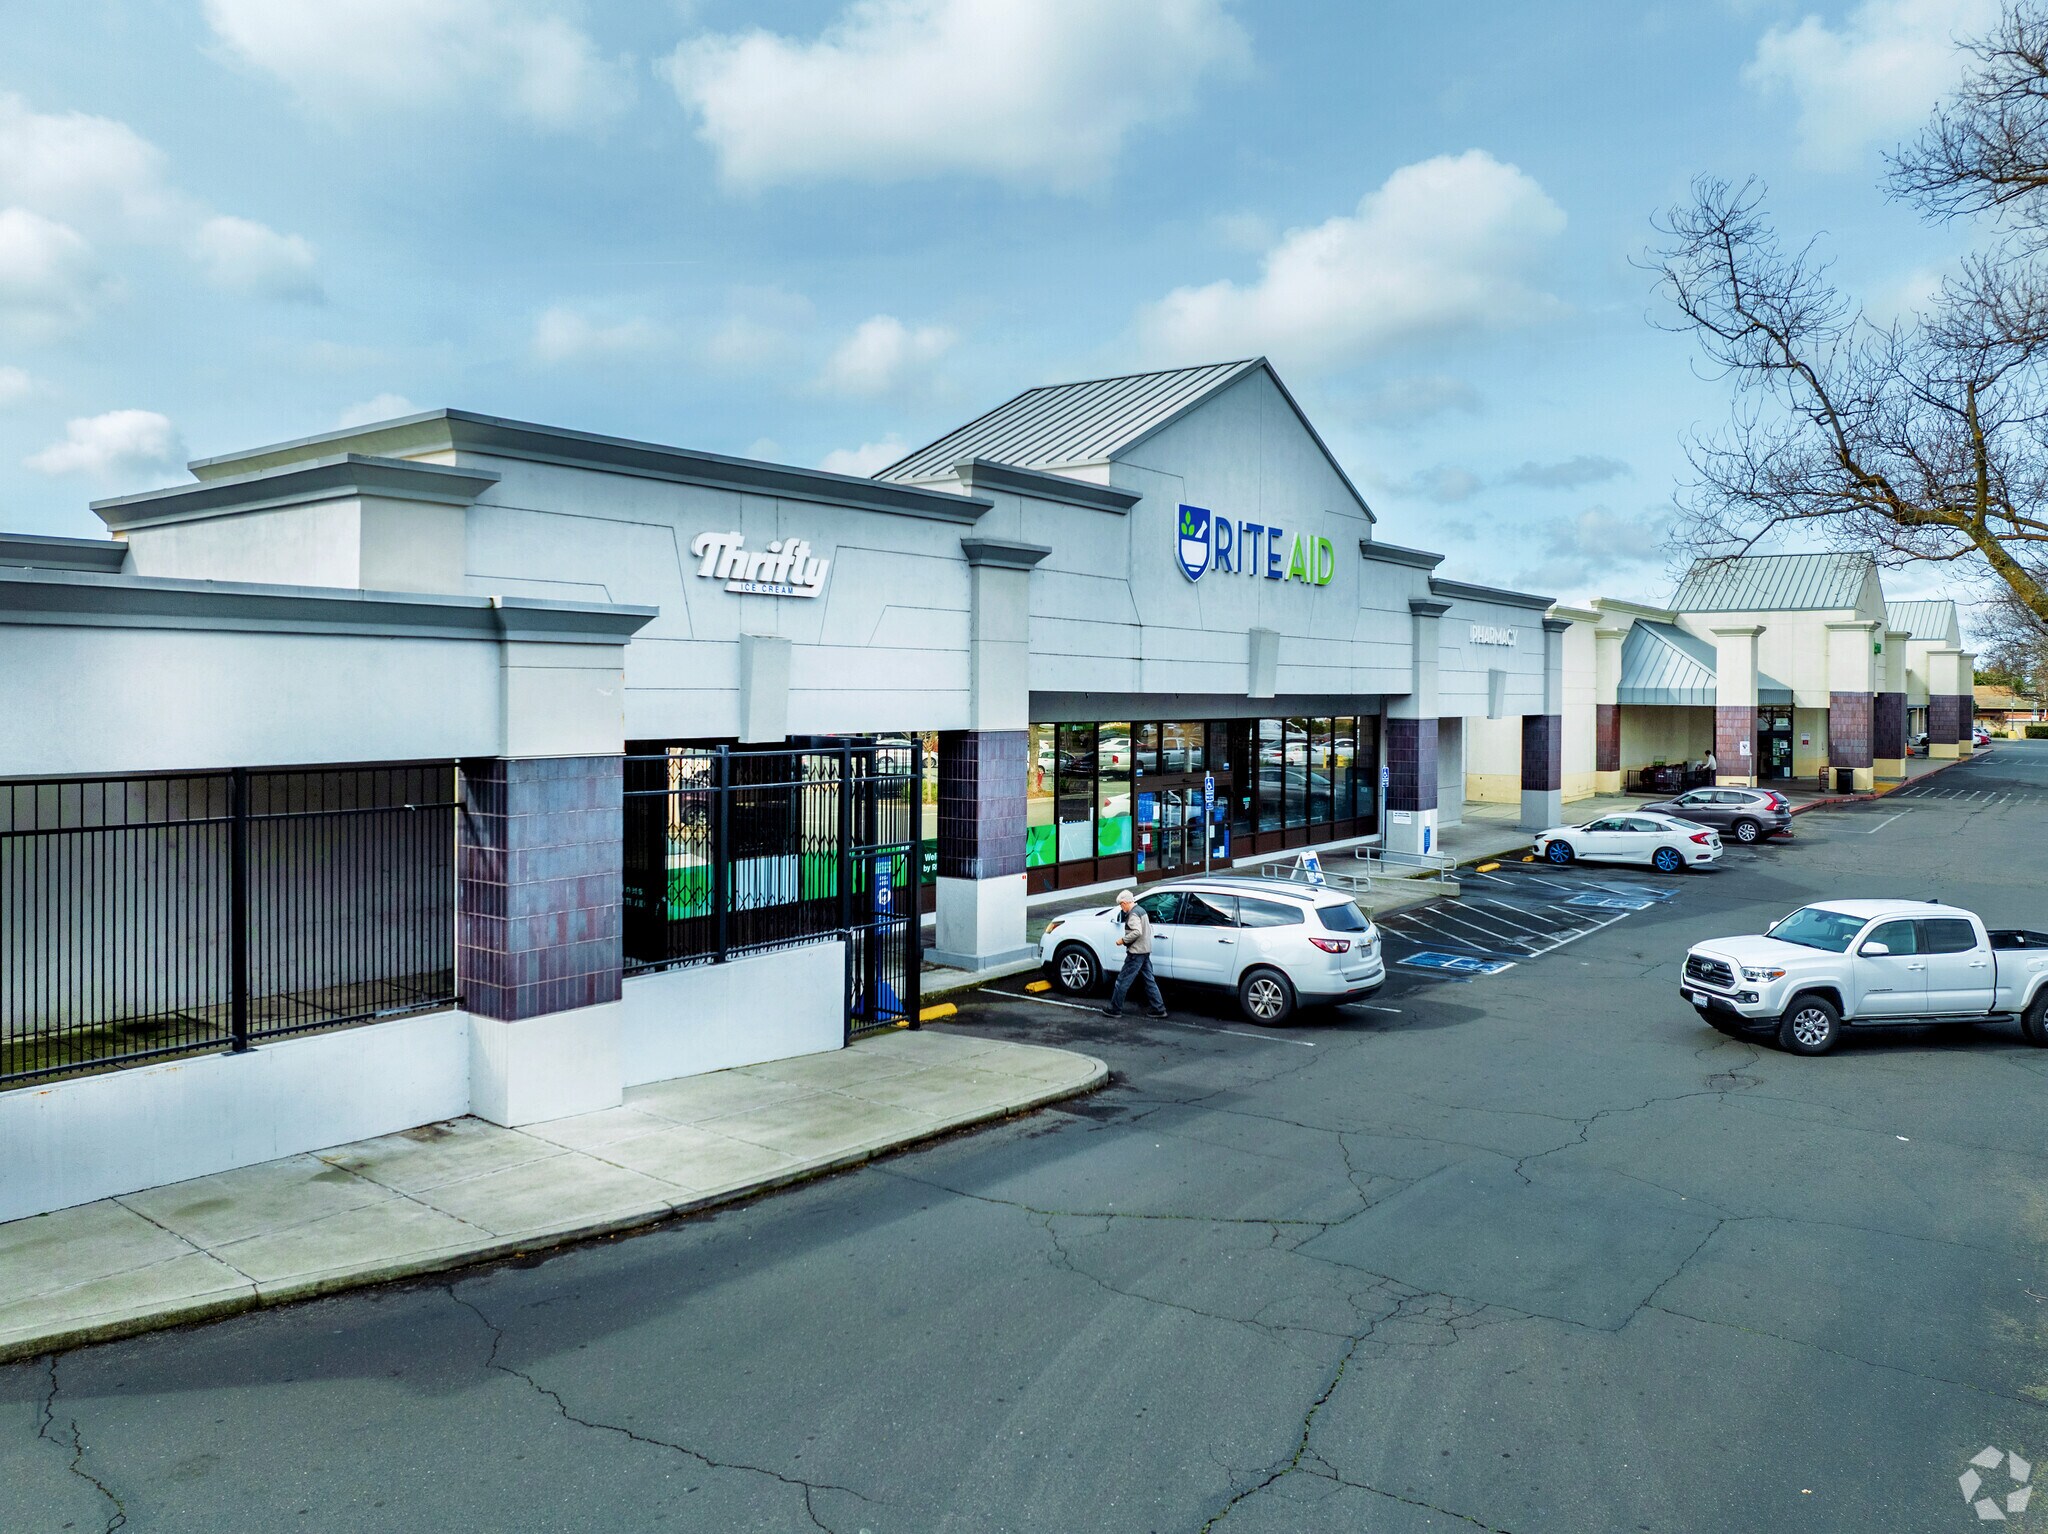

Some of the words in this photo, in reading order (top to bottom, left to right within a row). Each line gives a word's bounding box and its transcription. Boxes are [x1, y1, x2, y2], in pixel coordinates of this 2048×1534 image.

[691, 531, 830, 597] Thrifty
[1211, 516, 1283, 579] RITE
[1284, 532, 1335, 586] AID
[740, 583, 757, 592] ICE
[761, 584, 794, 594] CREAM
[1470, 624, 1518, 646] PHARMACY
